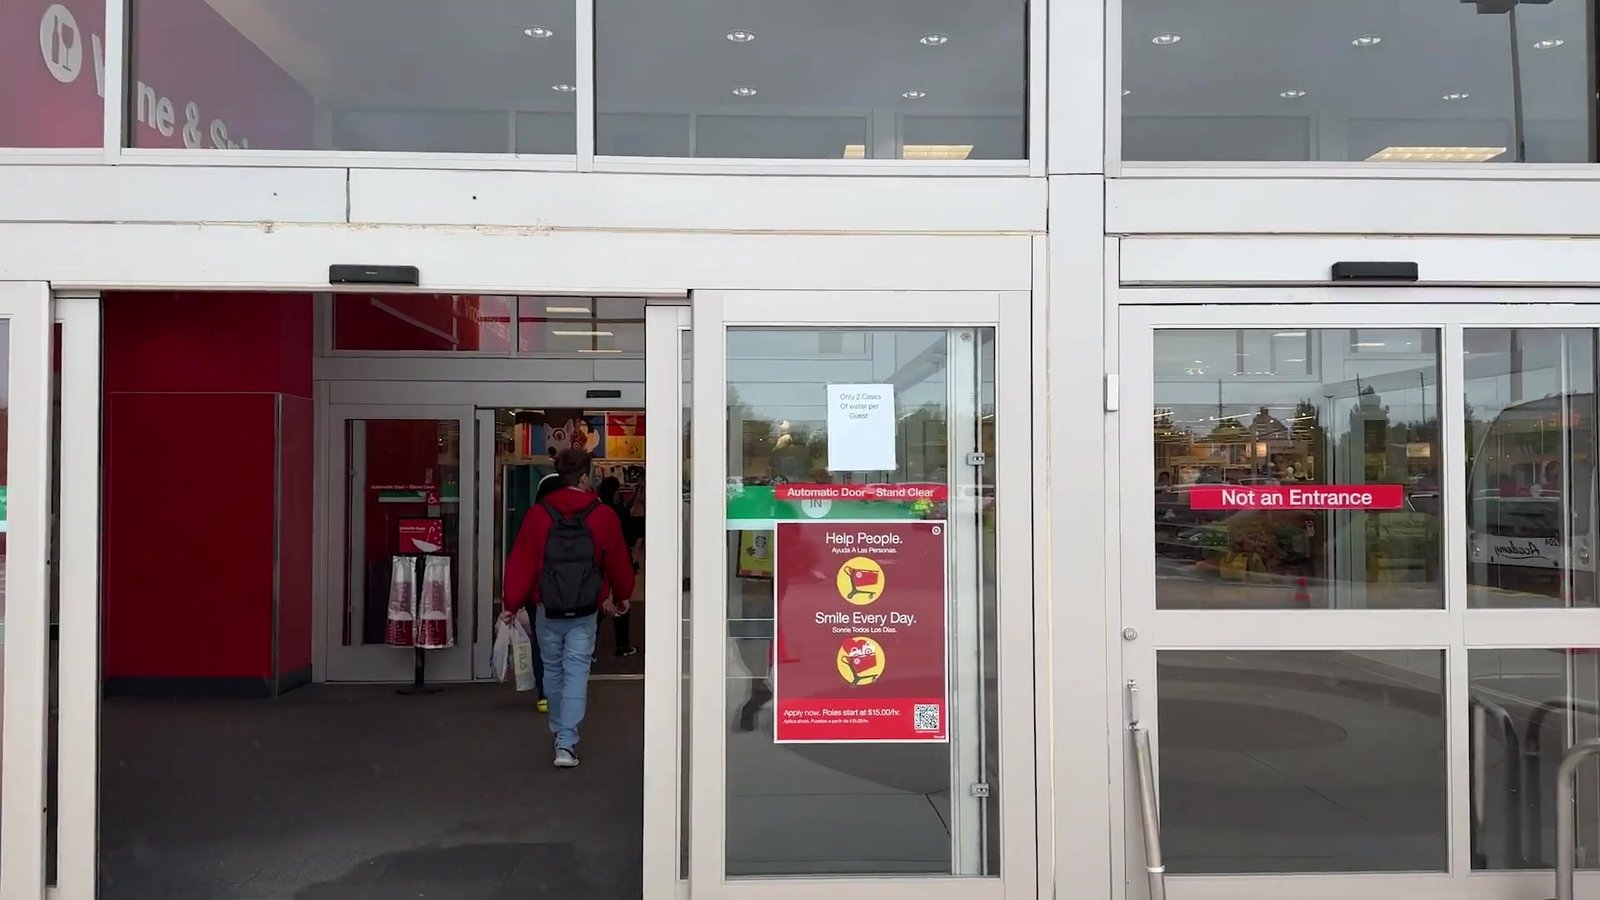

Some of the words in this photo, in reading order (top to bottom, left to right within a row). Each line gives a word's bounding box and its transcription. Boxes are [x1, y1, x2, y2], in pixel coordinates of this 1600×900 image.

[182, 101, 203, 149] &
[839, 393, 855, 401] Only
[839, 402, 848, 410] Of
[787, 487, 839, 497] Automatic
[840, 487, 865, 497] Door
[876, 487, 905, 497] Stand
[907, 487, 934, 497] Clear
[1221, 489, 1255, 506] Not
[1260, 492, 1283, 506] an
[1289, 489, 1373, 506] Entrance
[810, 499, 822, 508] IN
[825, 531, 854, 547] Help
[857, 531, 903, 547] People.
[815, 611, 850, 624] Smile
[852, 611, 887, 627] Every
[890, 611, 917, 627] Day.
[783, 709, 803, 717] Apply
[822, 708, 841, 716] Roles
